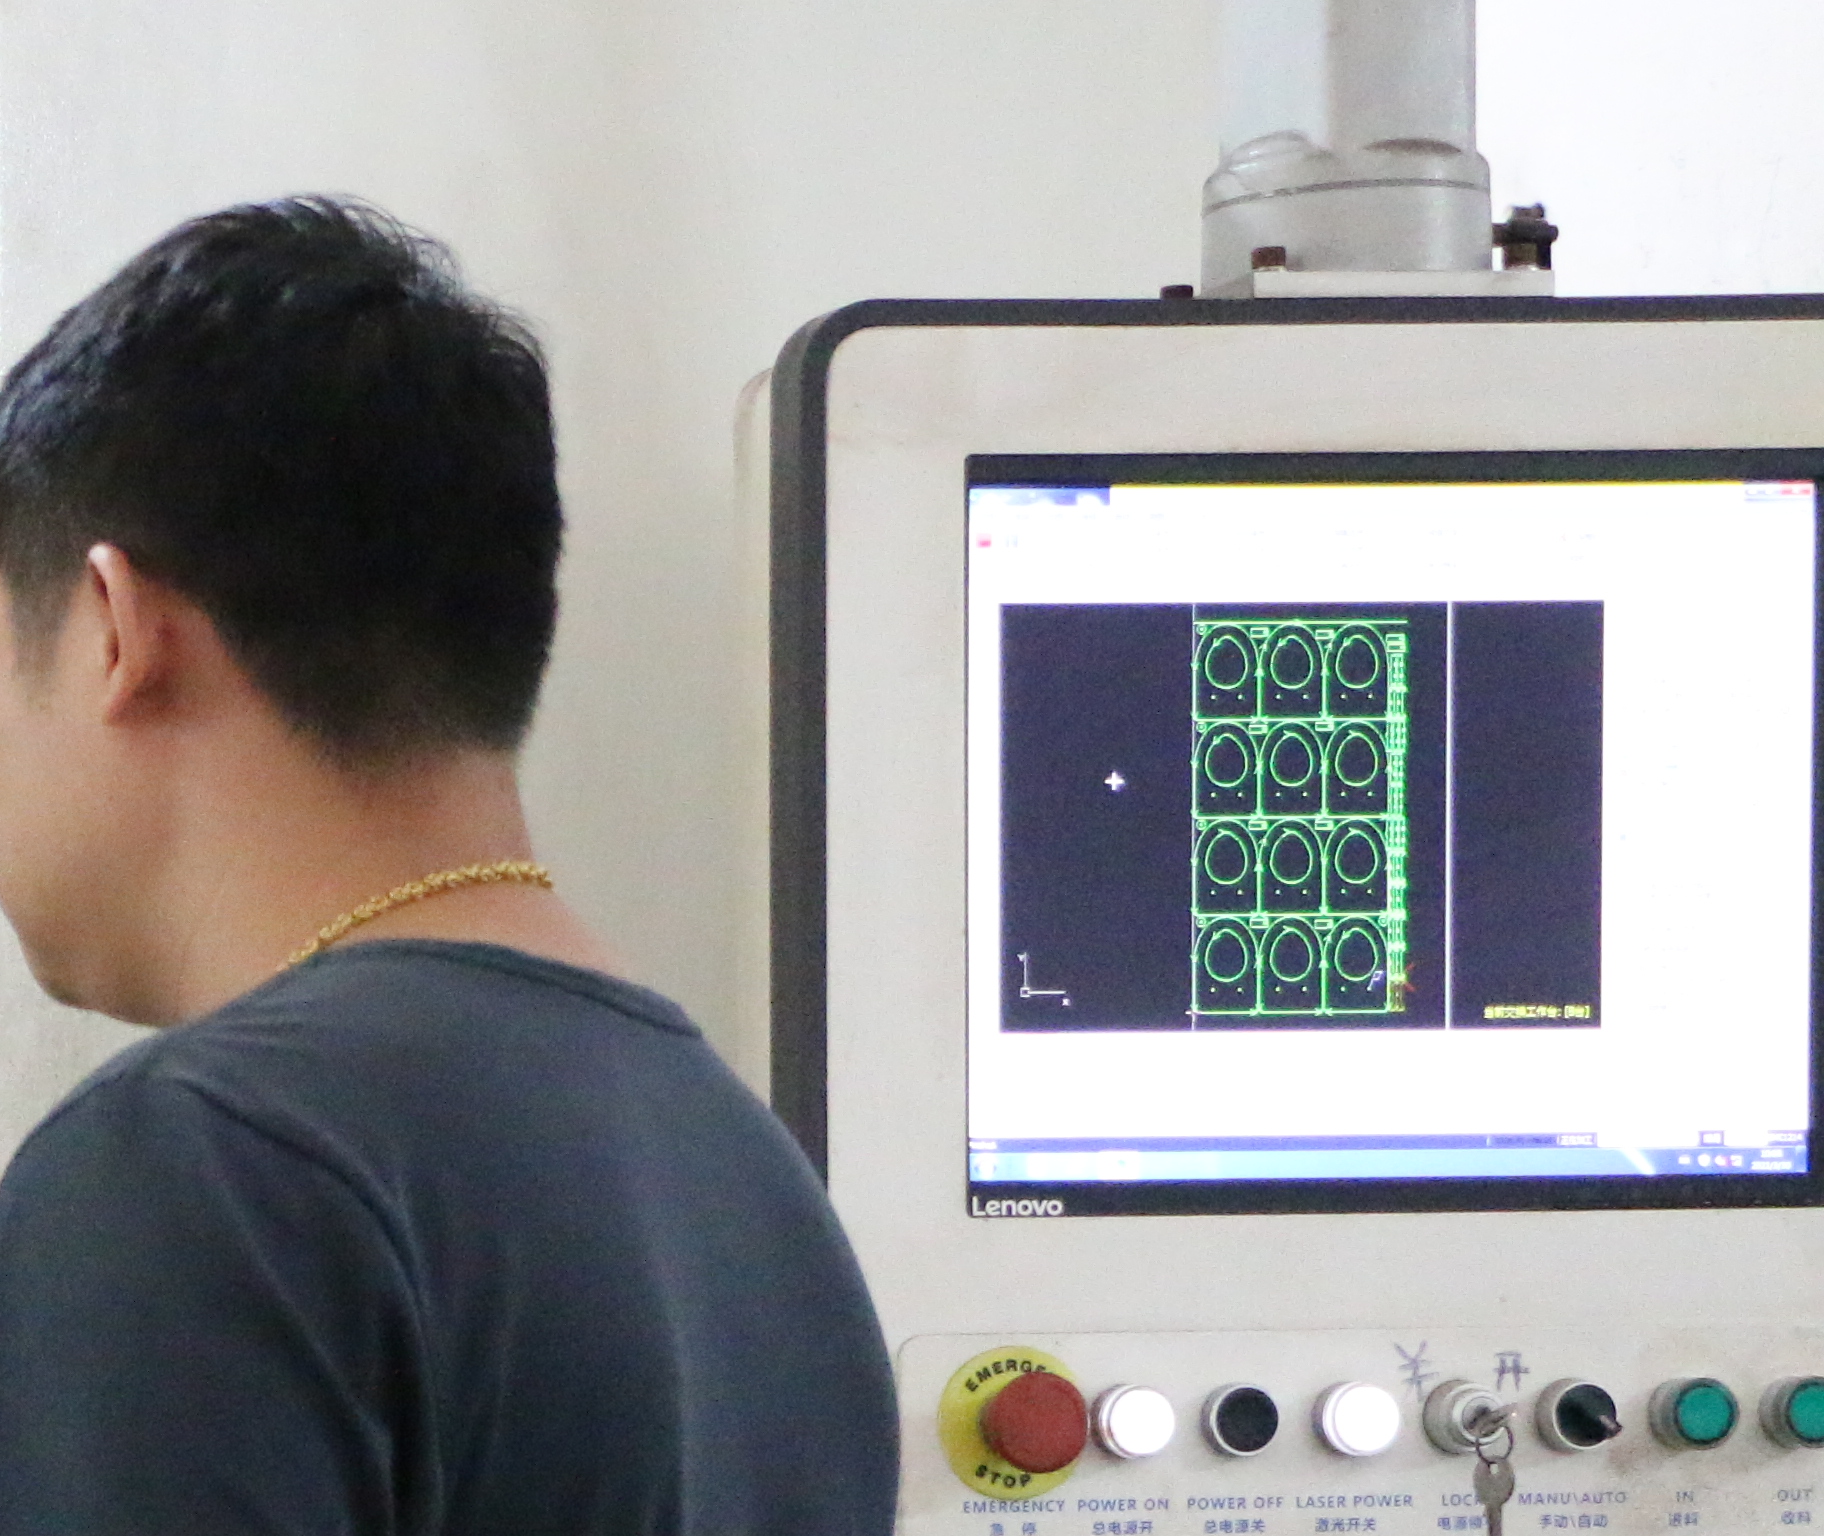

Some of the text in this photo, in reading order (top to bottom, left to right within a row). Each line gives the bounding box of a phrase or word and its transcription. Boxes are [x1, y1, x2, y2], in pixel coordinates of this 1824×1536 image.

[972, 1196, 1064, 1217] Lenovo
[975, 1464, 1033, 1489] STOP
[1295, 1494, 1414, 1509] LASER POWER
[1676, 1491, 1694, 1502] IN
[1777, 1489, 1813, 1502] OUT
[963, 1499, 1066, 1513] EMERGENCY
[1077, 1499, 1170, 1512] POWER ON
[1187, 1496, 1285, 1511] POWER OFF
[1204, 1518, 1266, 1534] 总电源关
[1315, 1517, 1376, 1533] 激光开关
